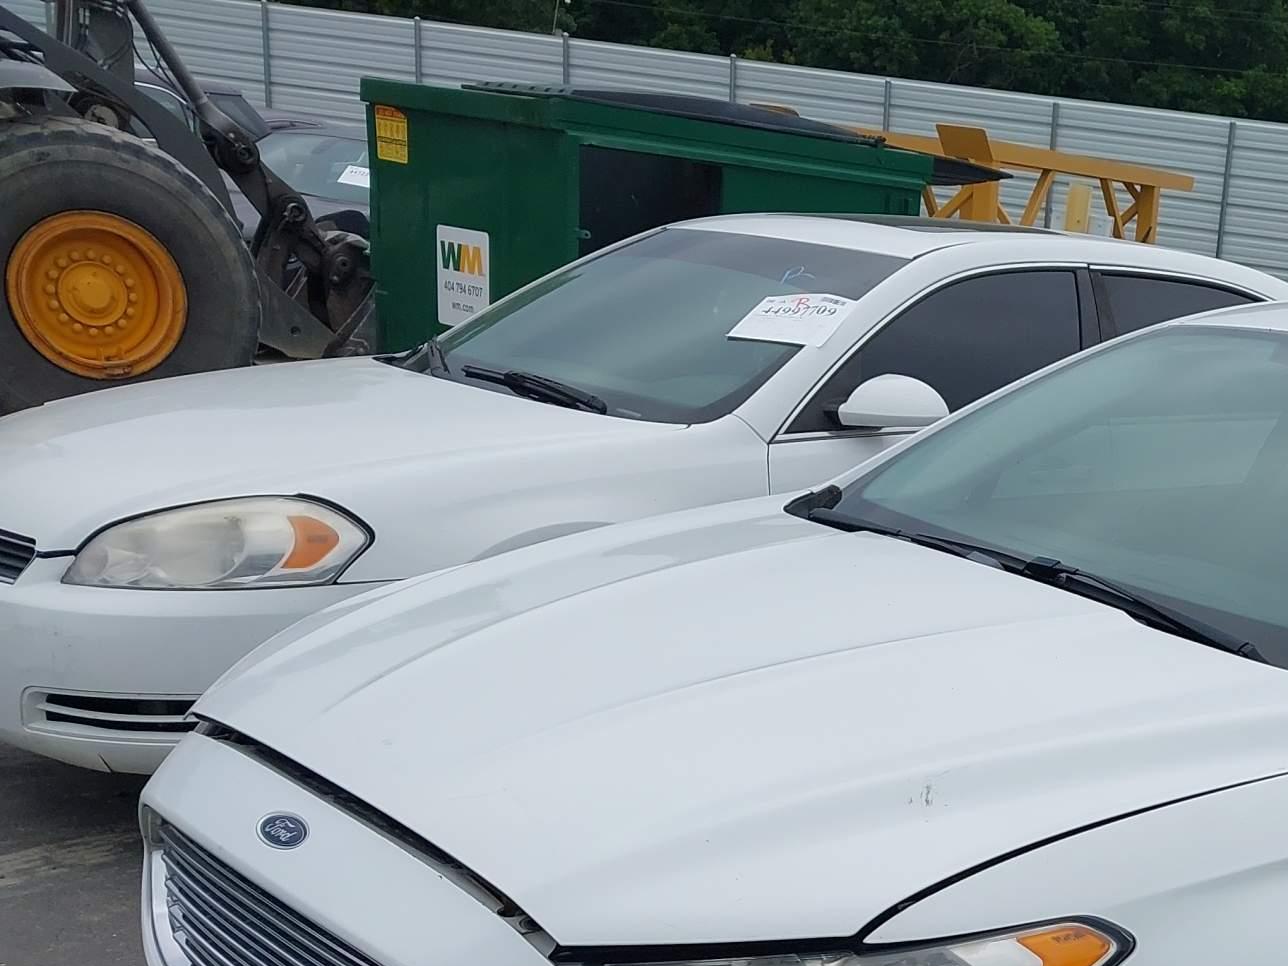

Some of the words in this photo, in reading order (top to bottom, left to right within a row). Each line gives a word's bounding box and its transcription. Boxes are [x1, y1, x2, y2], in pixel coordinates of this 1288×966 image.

[440, 240, 483, 276] WM
[444, 280, 455, 291] 404
[456, 282, 467, 295] 794
[467, 284, 483, 297] 6707
[264, 818, 298, 842] Ford
